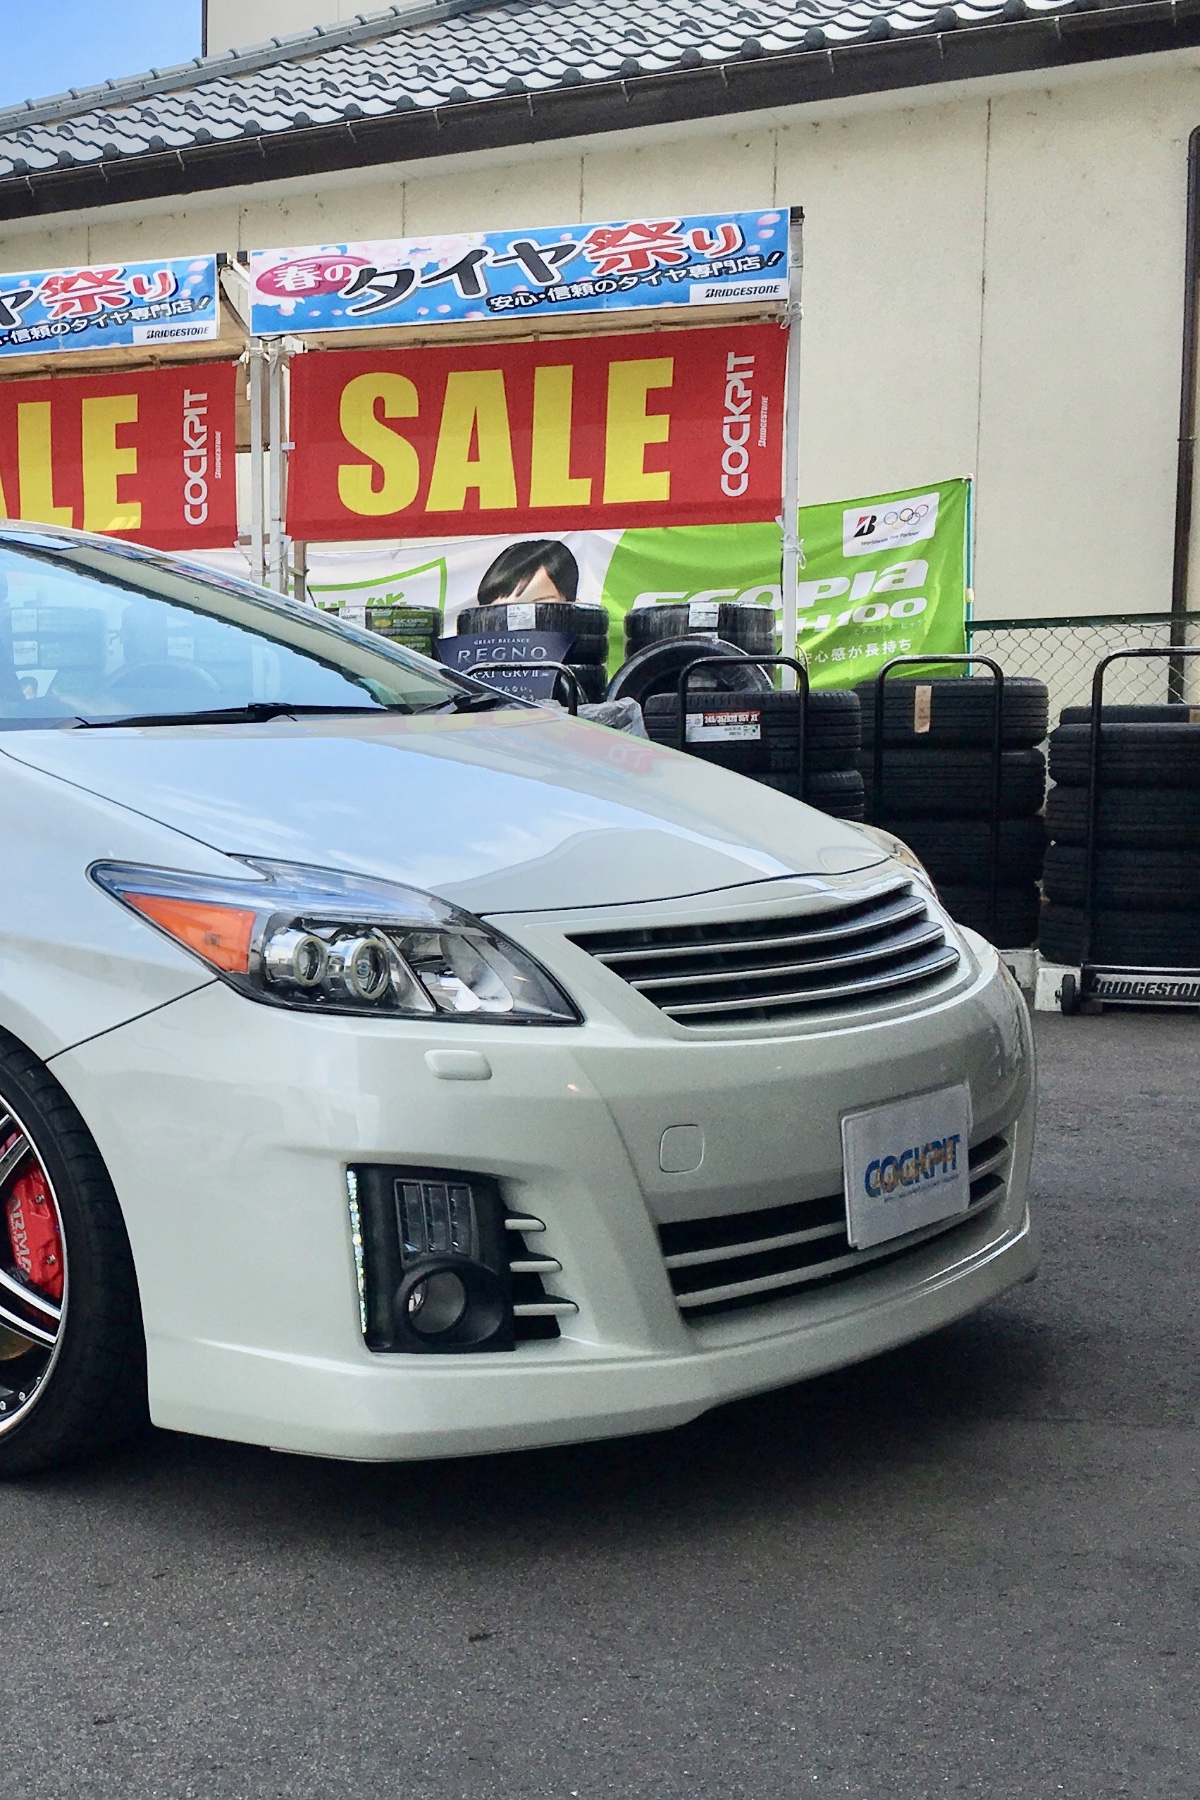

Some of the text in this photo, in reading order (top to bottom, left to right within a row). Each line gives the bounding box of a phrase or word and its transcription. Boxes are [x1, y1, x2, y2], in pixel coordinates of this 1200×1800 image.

[704, 284, 780, 299] BRIDGESTONE
[146, 326, 210, 340] BRIDGESTONE
[183, 388, 209, 526] COCKPIT
[337, 356, 674, 516] SALE
[720, 351, 757, 498] COCKPIT
[457, 646, 548, 664] REGNO
[865, 1133, 960, 1198] COCKPIT
